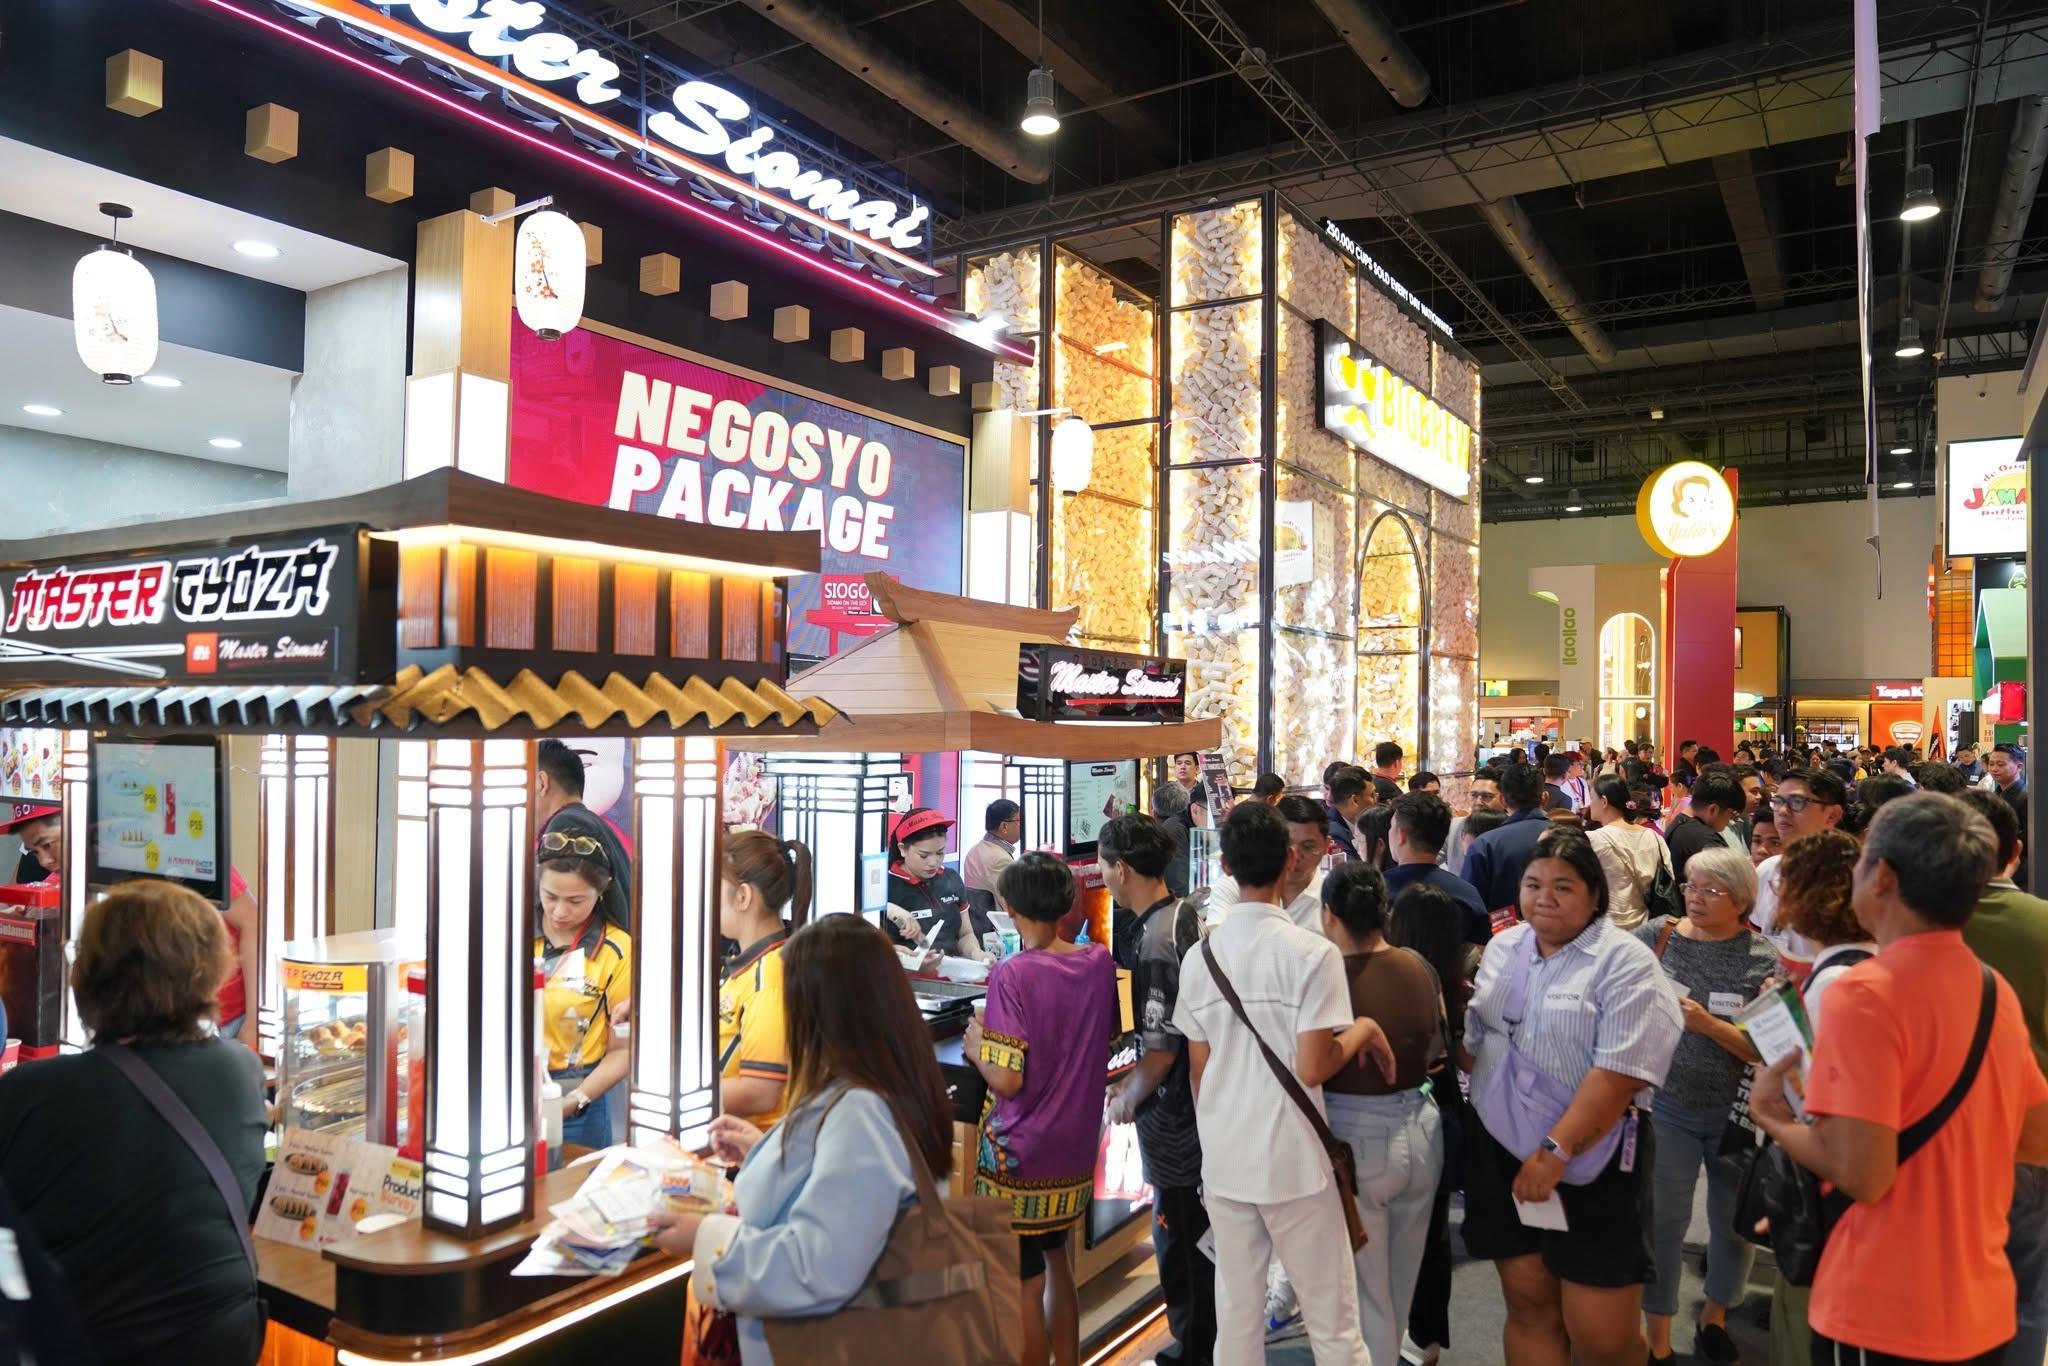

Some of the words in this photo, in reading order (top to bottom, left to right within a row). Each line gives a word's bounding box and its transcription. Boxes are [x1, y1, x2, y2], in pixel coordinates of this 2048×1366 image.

[648, 81, 929, 248] Siomai
[1355, 245, 1373, 270] CUPS
[1373, 262, 1390, 285] SOLD
[1390, 276, 1408, 300] EVERY
[1409, 293, 1421, 311] DAY
[1421, 303, 1454, 338] NATIONWIDE
[614, 370, 892, 497] NEGOSYO
[1380, 364, 1471, 474] BIGBREW
[609, 444, 894, 559] PACKAGE
[6, 562, 171, 632] MASTER
[173, 538, 339, 622] GYOZA
[824, 582, 870, 599] SIOGO
[219, 638, 269, 659] Master
[273, 636, 328, 659] Siomai
[1562, 607, 1577, 665] llaollao
[1051, 661, 1119, 695] Master
[1121, 669, 1181, 698] Siomai
[1876, 686, 1910, 698] Tapa
[301, 970, 343, 981] GYOZA
[1547, 993, 1580, 1001] VISITOR
[1710, 999, 1742, 1008] VISITOR
[383, 1174, 421, 1200] Product
